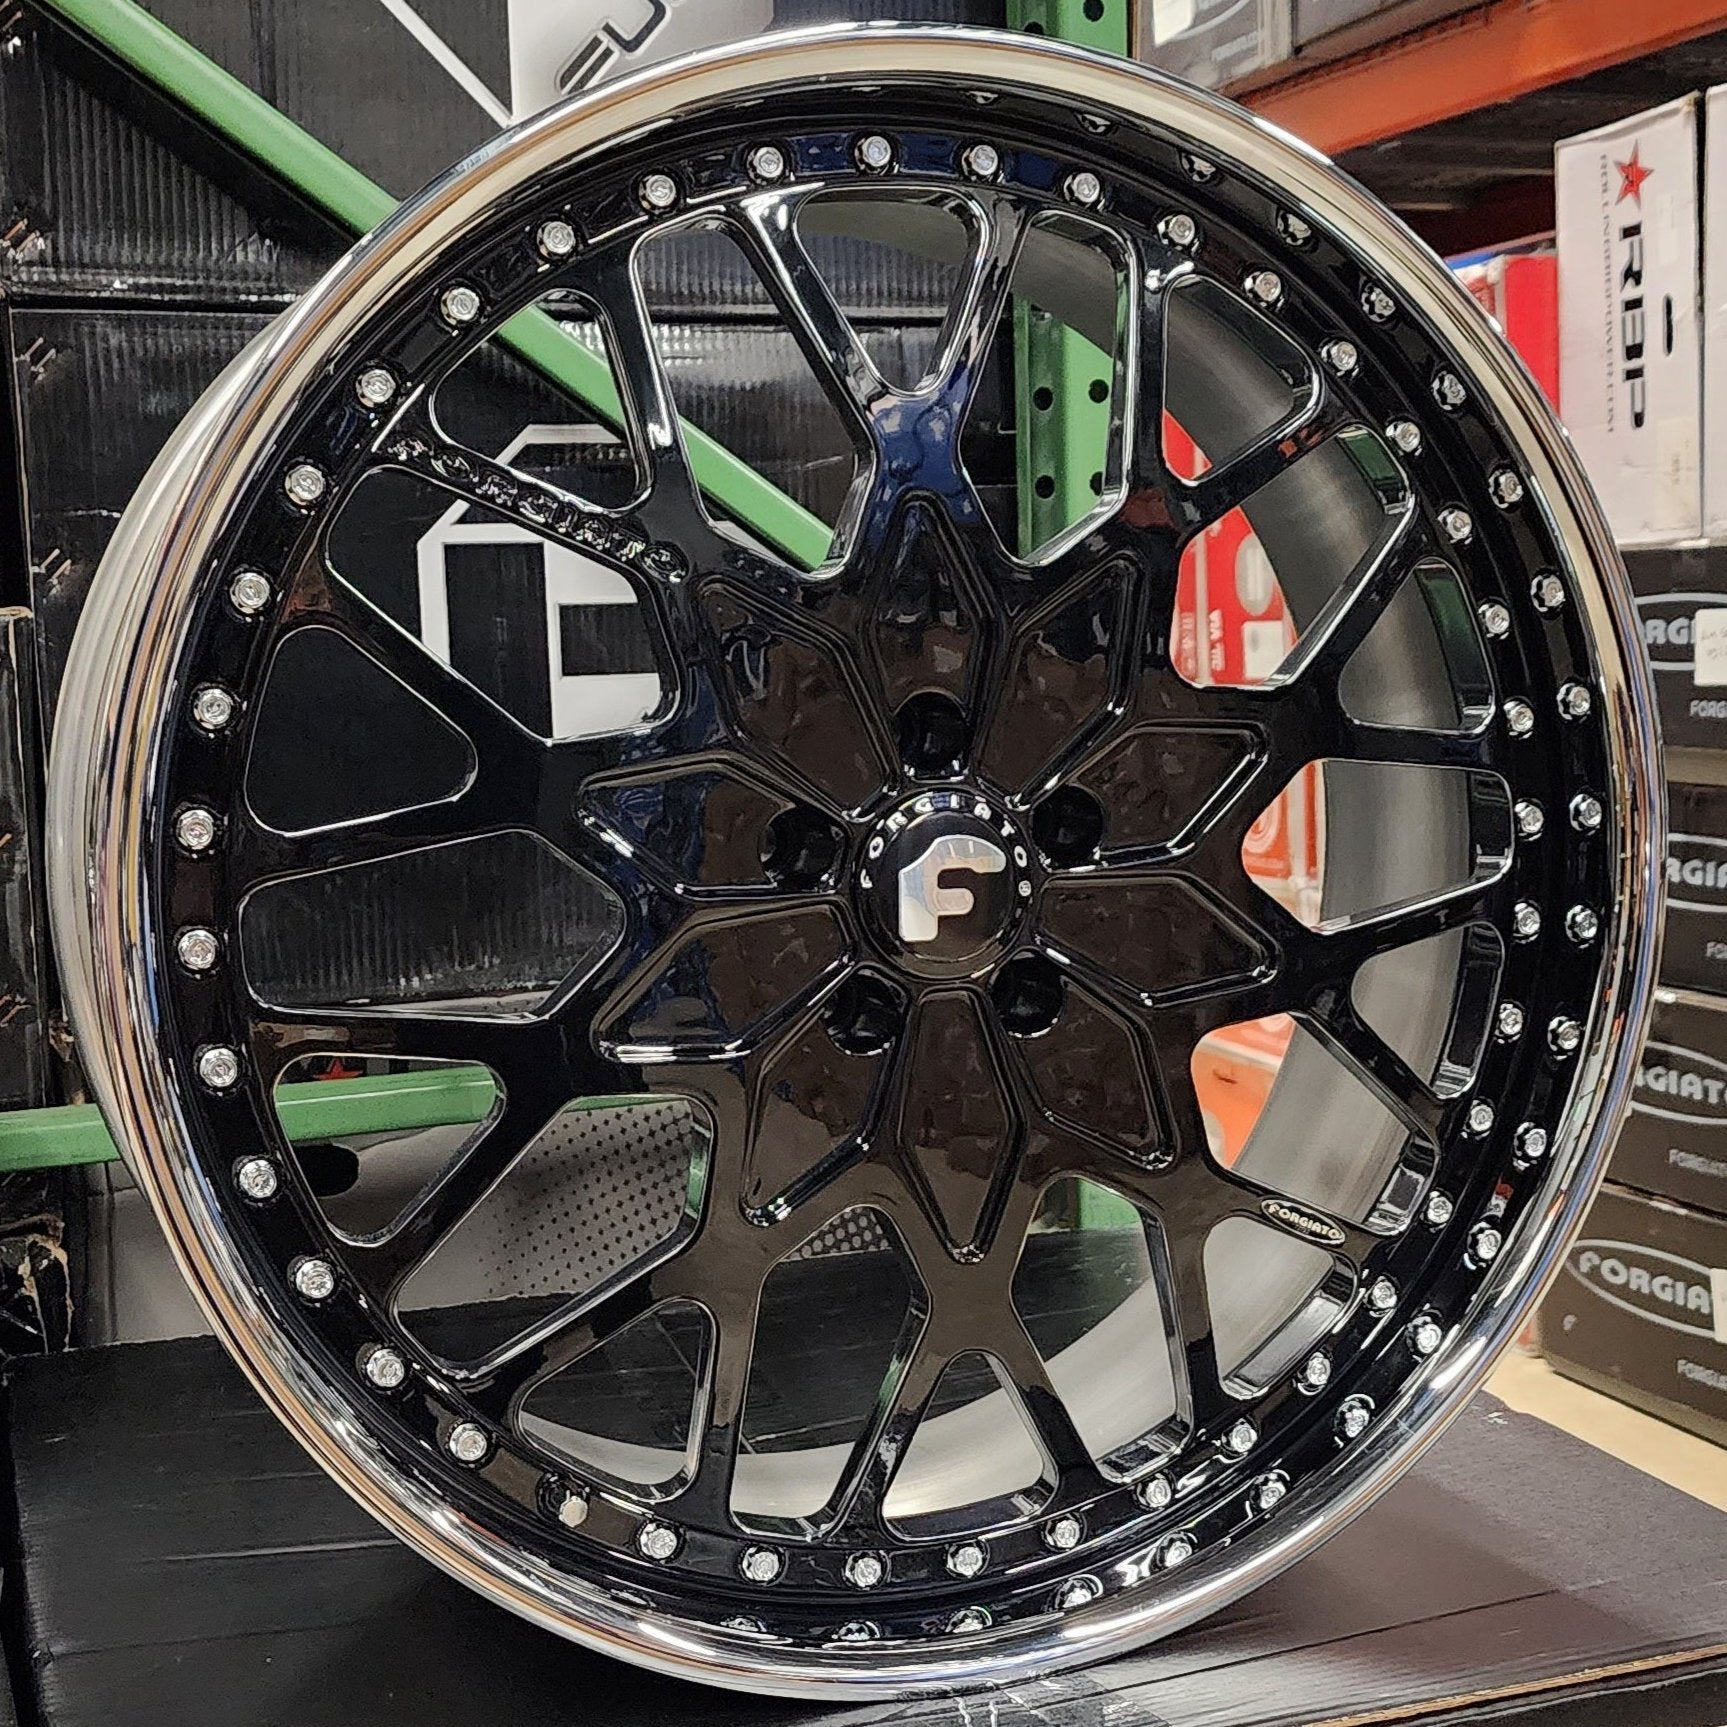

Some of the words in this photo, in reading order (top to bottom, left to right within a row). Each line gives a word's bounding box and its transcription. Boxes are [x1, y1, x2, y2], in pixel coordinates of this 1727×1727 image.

[1618, 220, 1646, 431] RBP
[1267, 1203, 1340, 1239] FORGIATO
[1579, 1250, 1711, 1315] FORGIA
